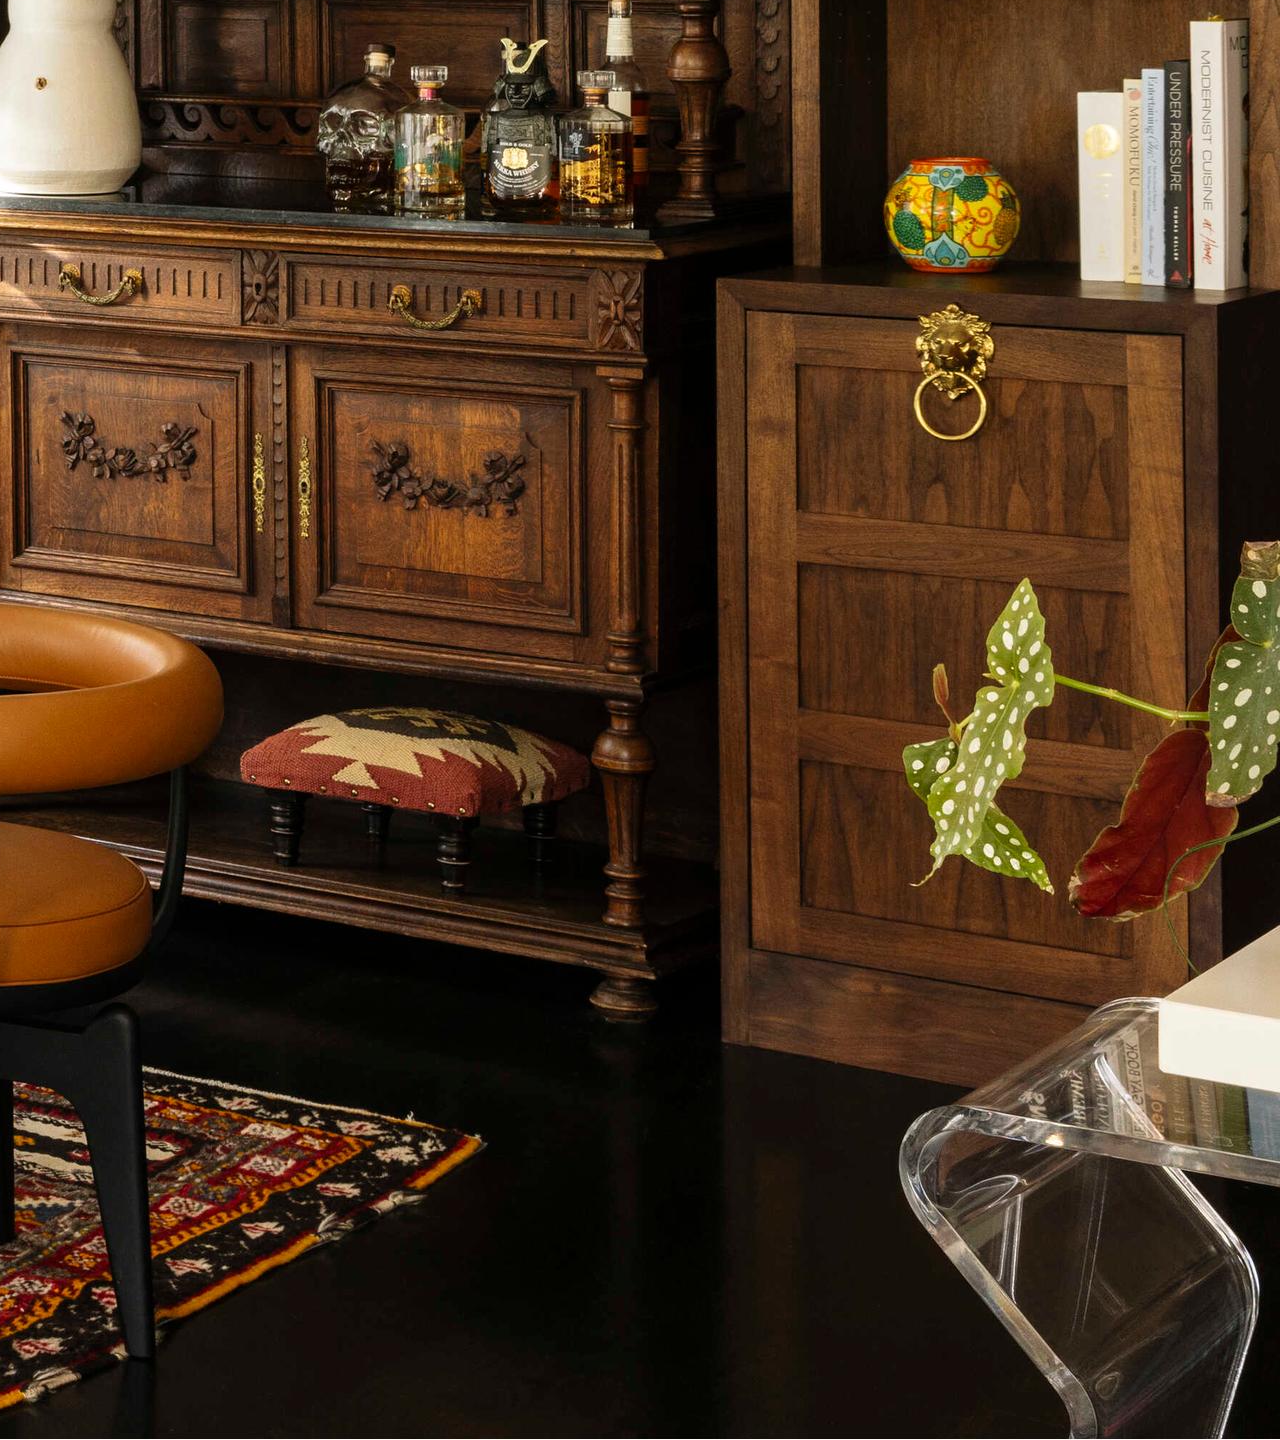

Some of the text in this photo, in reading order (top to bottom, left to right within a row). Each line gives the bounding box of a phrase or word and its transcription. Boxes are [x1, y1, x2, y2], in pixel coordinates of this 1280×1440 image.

[1144, 75, 1158, 133] Entertaining
[1169, 72, 1181, 120] UNDER
[493, 160, 540, 176] NIKKA WHISKY
[1128, 106, 1139, 187] MOMOFUKU
[1169, 123, 1182, 192] PRESSURE
[1200, 50, 1219, 265] MODERNIST CUISINE at Home
